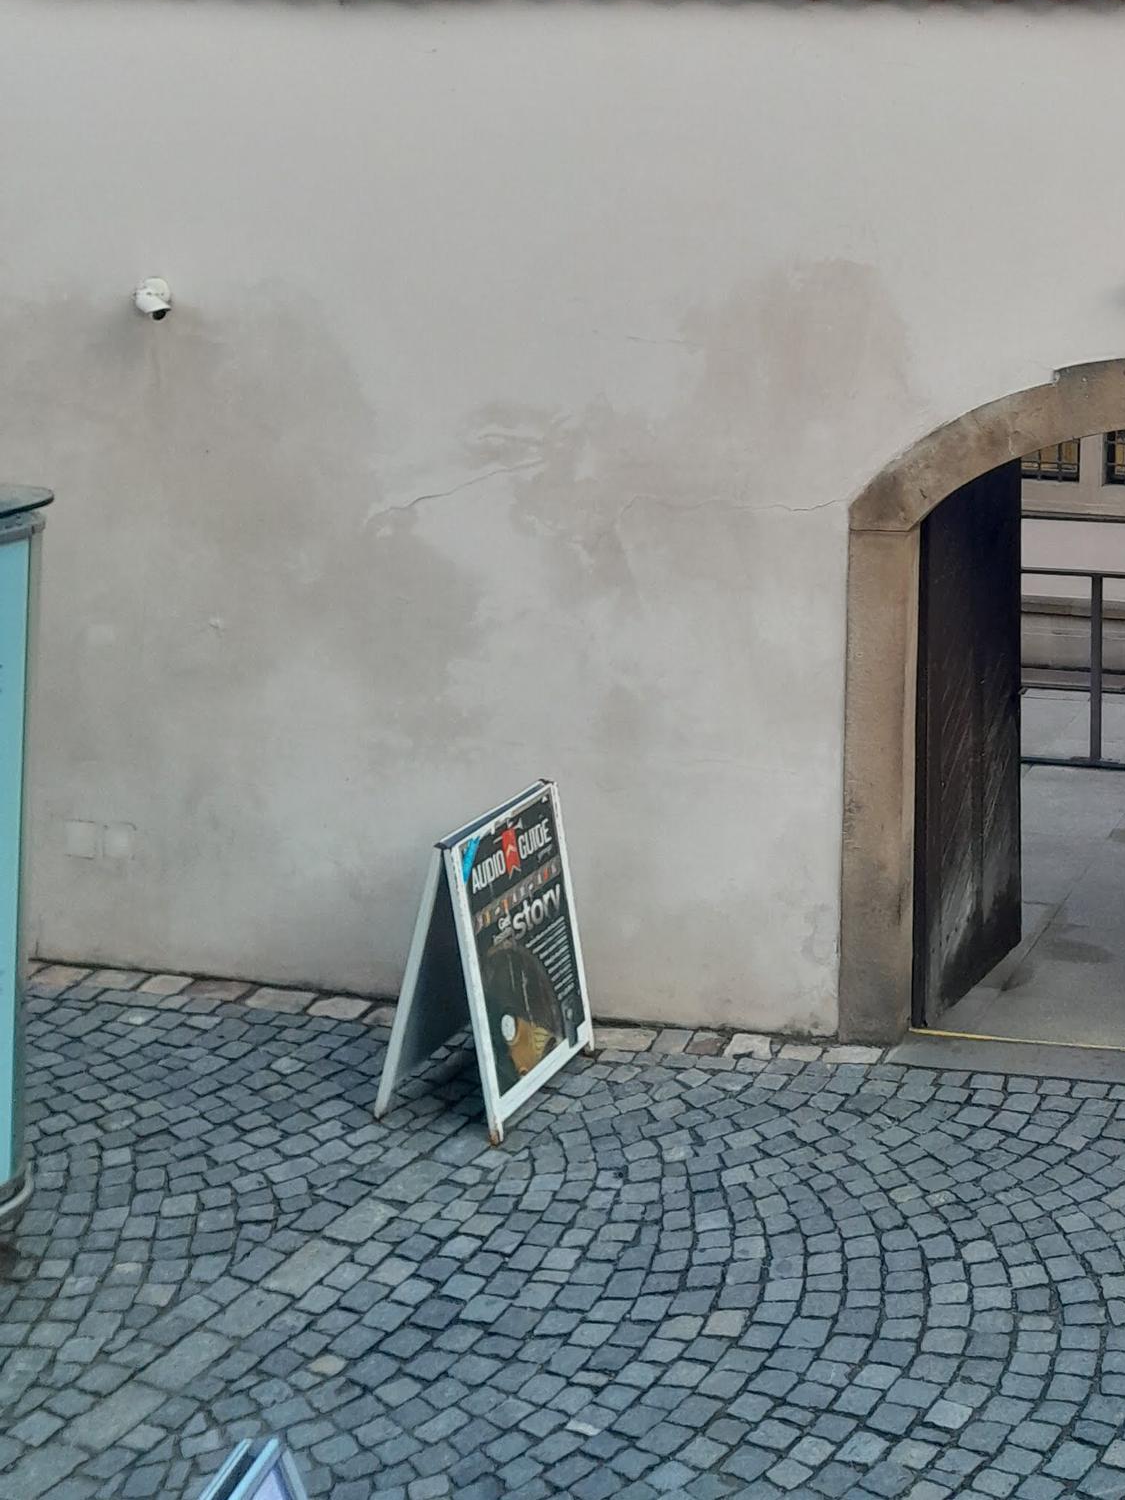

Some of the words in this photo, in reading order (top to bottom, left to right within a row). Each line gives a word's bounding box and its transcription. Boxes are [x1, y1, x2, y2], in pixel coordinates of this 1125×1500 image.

[472, 849, 506, 894] AUDIO
[517, 818, 552, 860] GUIDE
[513, 883, 561, 940] story
